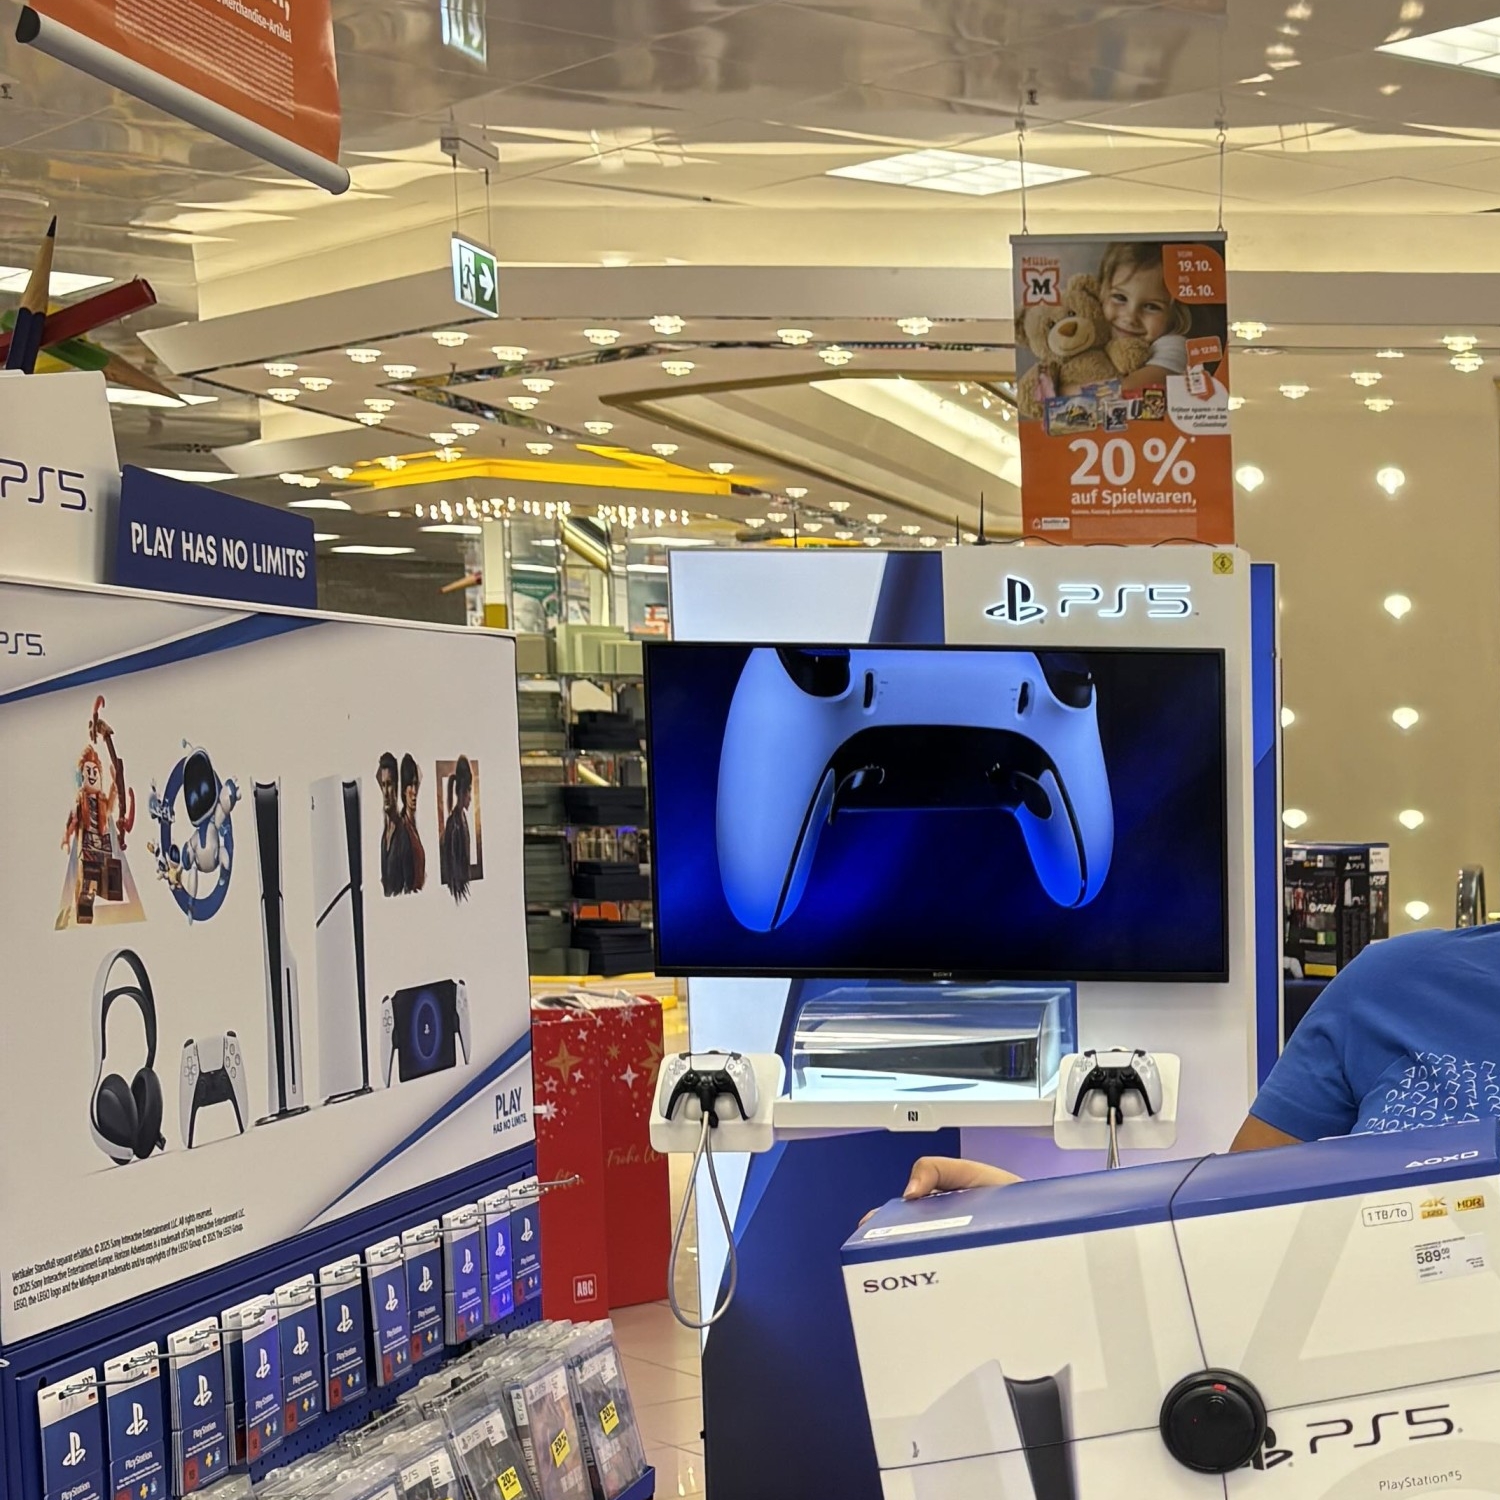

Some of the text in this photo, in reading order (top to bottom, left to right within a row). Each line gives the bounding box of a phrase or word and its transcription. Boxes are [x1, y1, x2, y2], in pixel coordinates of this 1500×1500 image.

[1022, 255, 1060, 268] Müller
[1178, 260, 1213, 272] 19.10.
[1031, 278, 1052, 295] M
[1178, 284, 1215, 297] 26.10.
[1071, 488, 1197, 508] auf Spielwaren,
[130, 521, 307, 579] PLAY HAS NO LIMITS
[1057, 583, 1193, 618] PS5
[495, 1086, 522, 1120] PLAY
[1419, 1196, 1447, 1208] 4K
[1457, 1197, 1482, 1209] HDR
[1374, 1208, 1408, 1221] TB/To
[12, 1267, 34, 1282] Vertikaler
[56, 1254, 73, 1267] separat
[100, 1239, 111, 1254] 2025
[110, 1237, 121, 1250] Sony
[121, 1231, 142, 1245] Interactive
[142, 1222, 171, 1238] Entertainment
[19, 1281, 31, 1295] 2025
[31, 1278, 43, 1290] Sony
[43, 1270, 67, 1285] Interactive
[67, 1260, 98, 1277] Entertainment
[114, 1248, 130, 1261] Horizon
[130, 1241, 153, 1255] Adventures
[160, 1231, 181, 1247] trademark
[37, 1289, 51, 1303] LEGO
[50, 1287, 61, 1299] logo
[79, 1272, 101, 1286] Minifigure
[108, 1262, 131, 1277] trademarks
[576, 1280, 594, 1298] ABC
[863, 1271, 937, 1294] SONY
[193, 1420, 216, 1439] PlayStation
[1306, 1404, 1454, 1455] PS5
[125, 1450, 153, 1470] PlayStation
[500, 1470, 517, 1489] 20%
